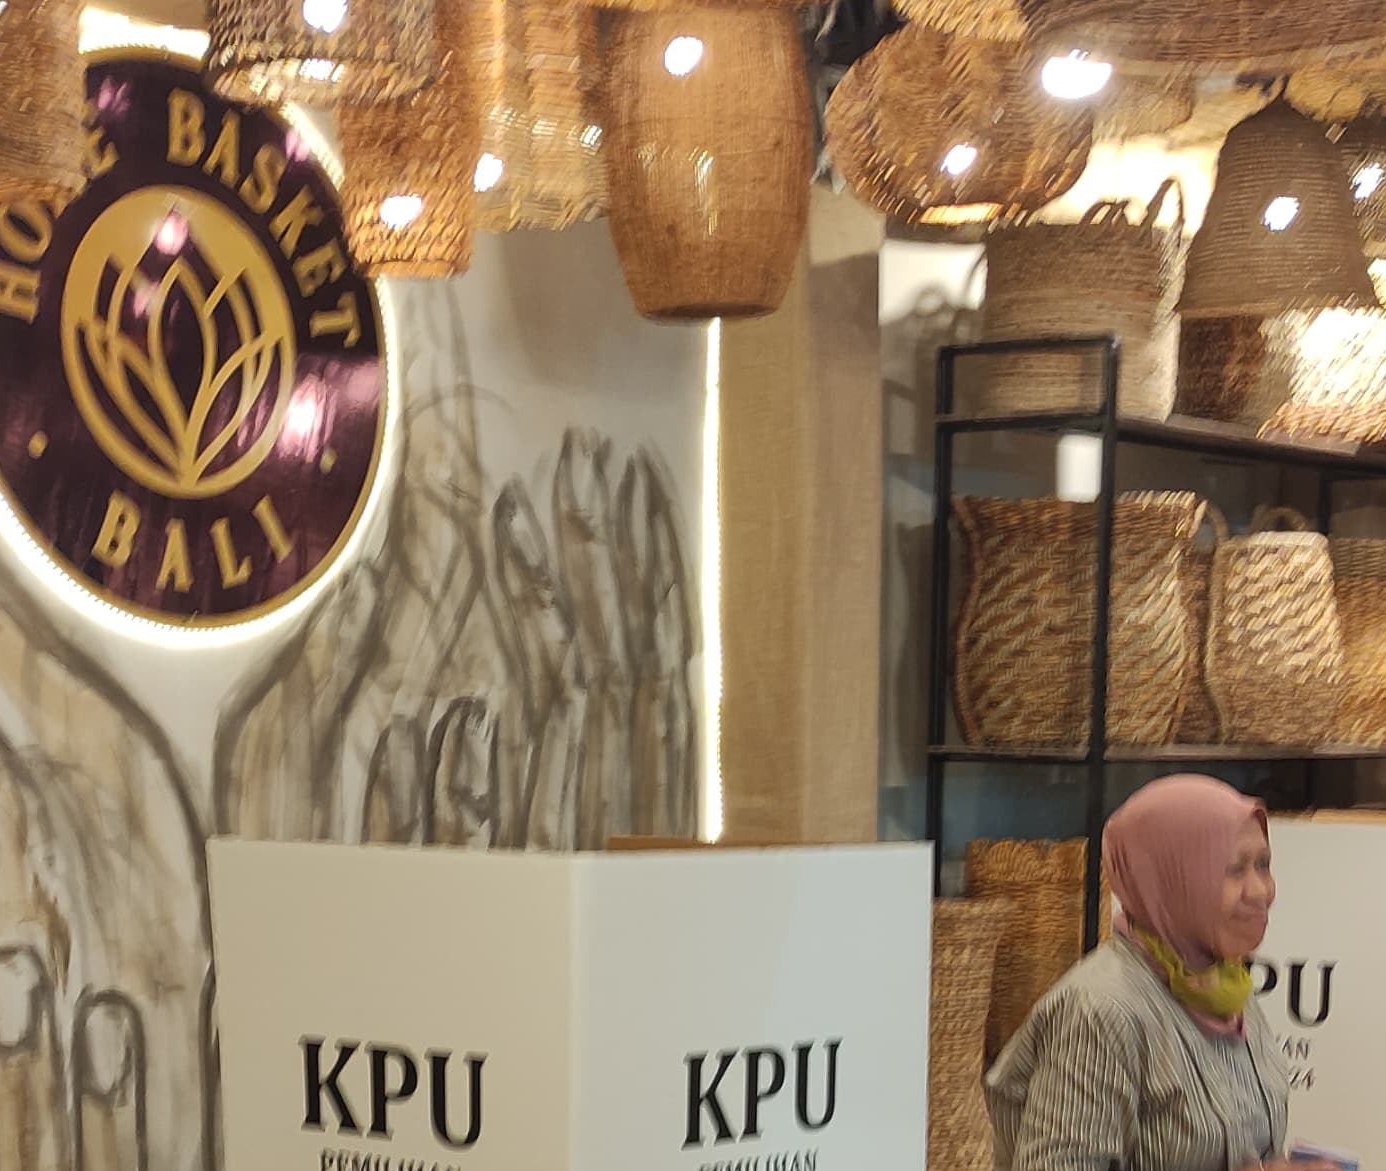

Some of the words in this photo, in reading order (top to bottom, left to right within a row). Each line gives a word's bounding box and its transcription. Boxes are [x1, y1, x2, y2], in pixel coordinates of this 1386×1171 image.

[167, 88, 361, 348] BASKET
[91, 490, 295, 591] BALI
[1244, 957, 1339, 1028] PU
[298, 1033, 489, 1152] KPU
[681, 1037, 843, 1150] KPU
